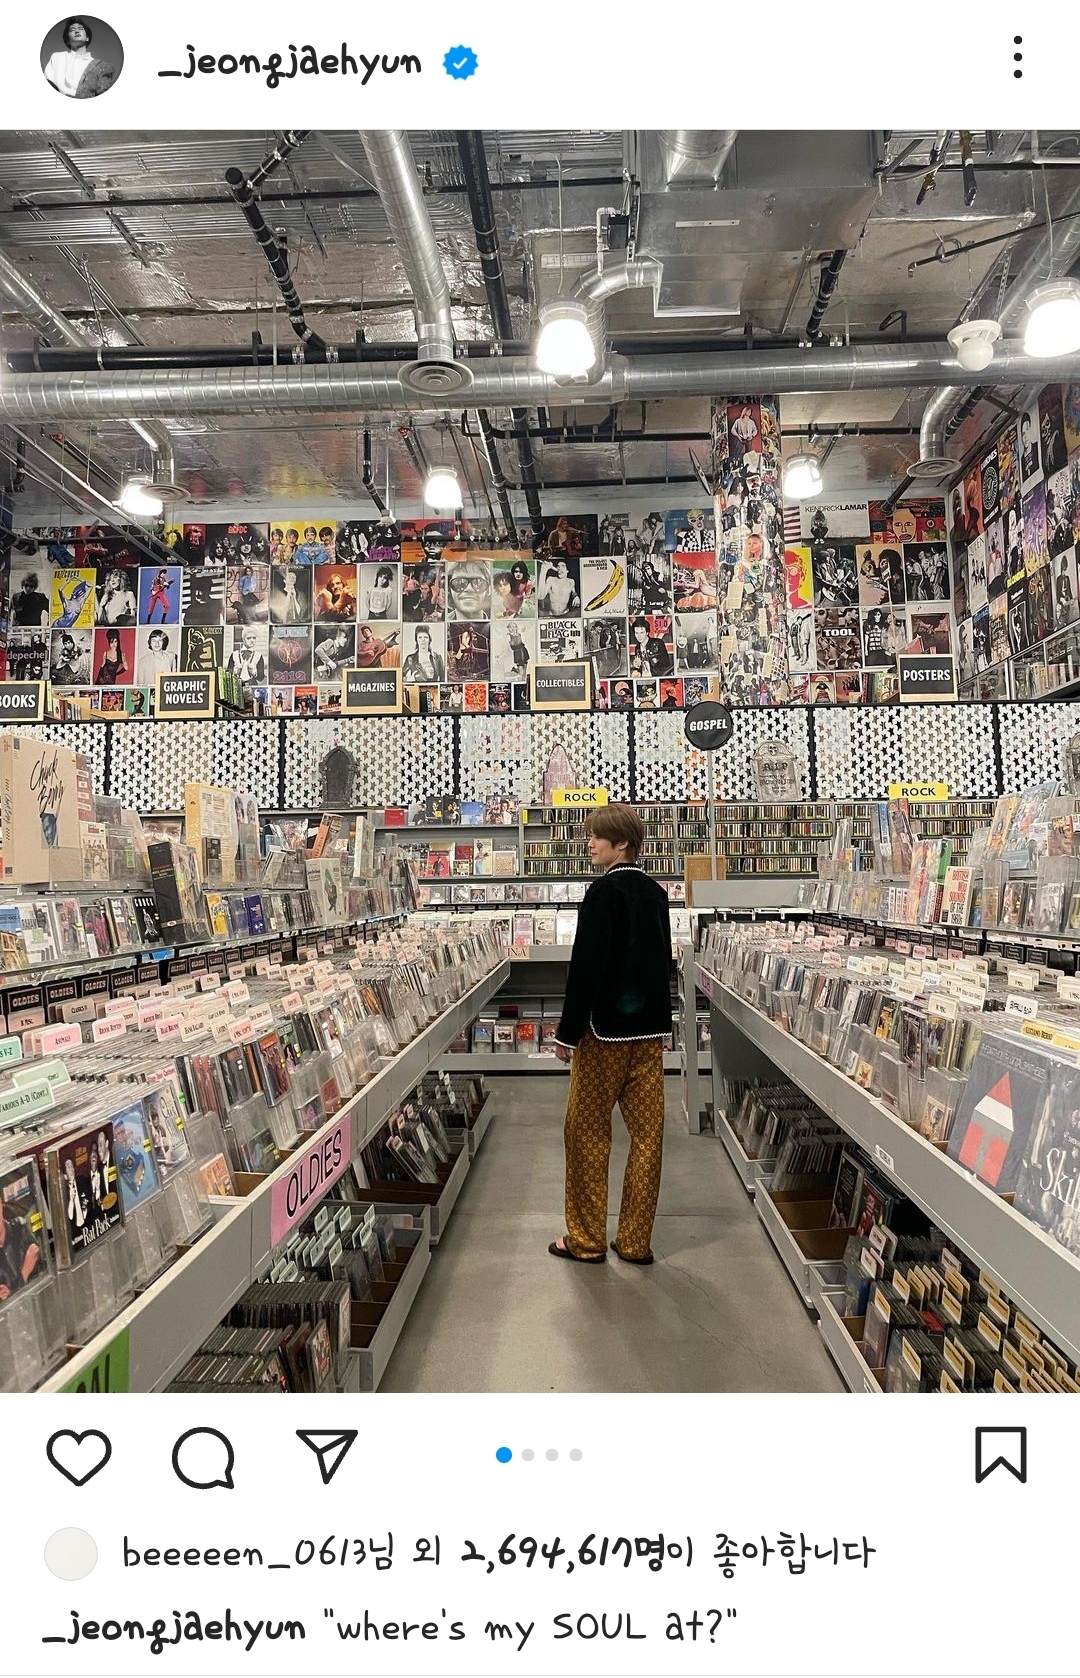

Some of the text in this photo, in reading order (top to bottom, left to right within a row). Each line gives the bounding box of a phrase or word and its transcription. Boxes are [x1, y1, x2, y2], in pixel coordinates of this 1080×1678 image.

[548, 620, 577, 629] BLACK
[654, 619, 668, 628] SID
[548, 629, 570, 638] FLAG
[823, 628, 855, 637] TOOL
[7, 650, 45, 660] depeche
[903, 669, 951, 682] POSTERS
[163, 680, 207, 693] GRAPHIC
[348, 682, 395, 693] MAGAZINES
[536, 678, 585, 688] COLLECTIBLES
[0, 695, 36, 708] OOKS
[165, 691, 204, 704] NOVELS
[689, 719, 728, 731] GOSPEL
[564, 793, 597, 802] ROCK
[901, 787, 936, 797] ROCK
[85, 980, 106, 991] OLDIES
[114, 974, 133, 986] OLDIES
[50, 987, 74, 999] OLDIES
[12, 994, 40, 1006] OLDIES
[19, 1094, 30, 1105] A-D
[286, 1128, 342, 1218] OLDIES
[82, 1213, 112, 1247] Rat Pack
